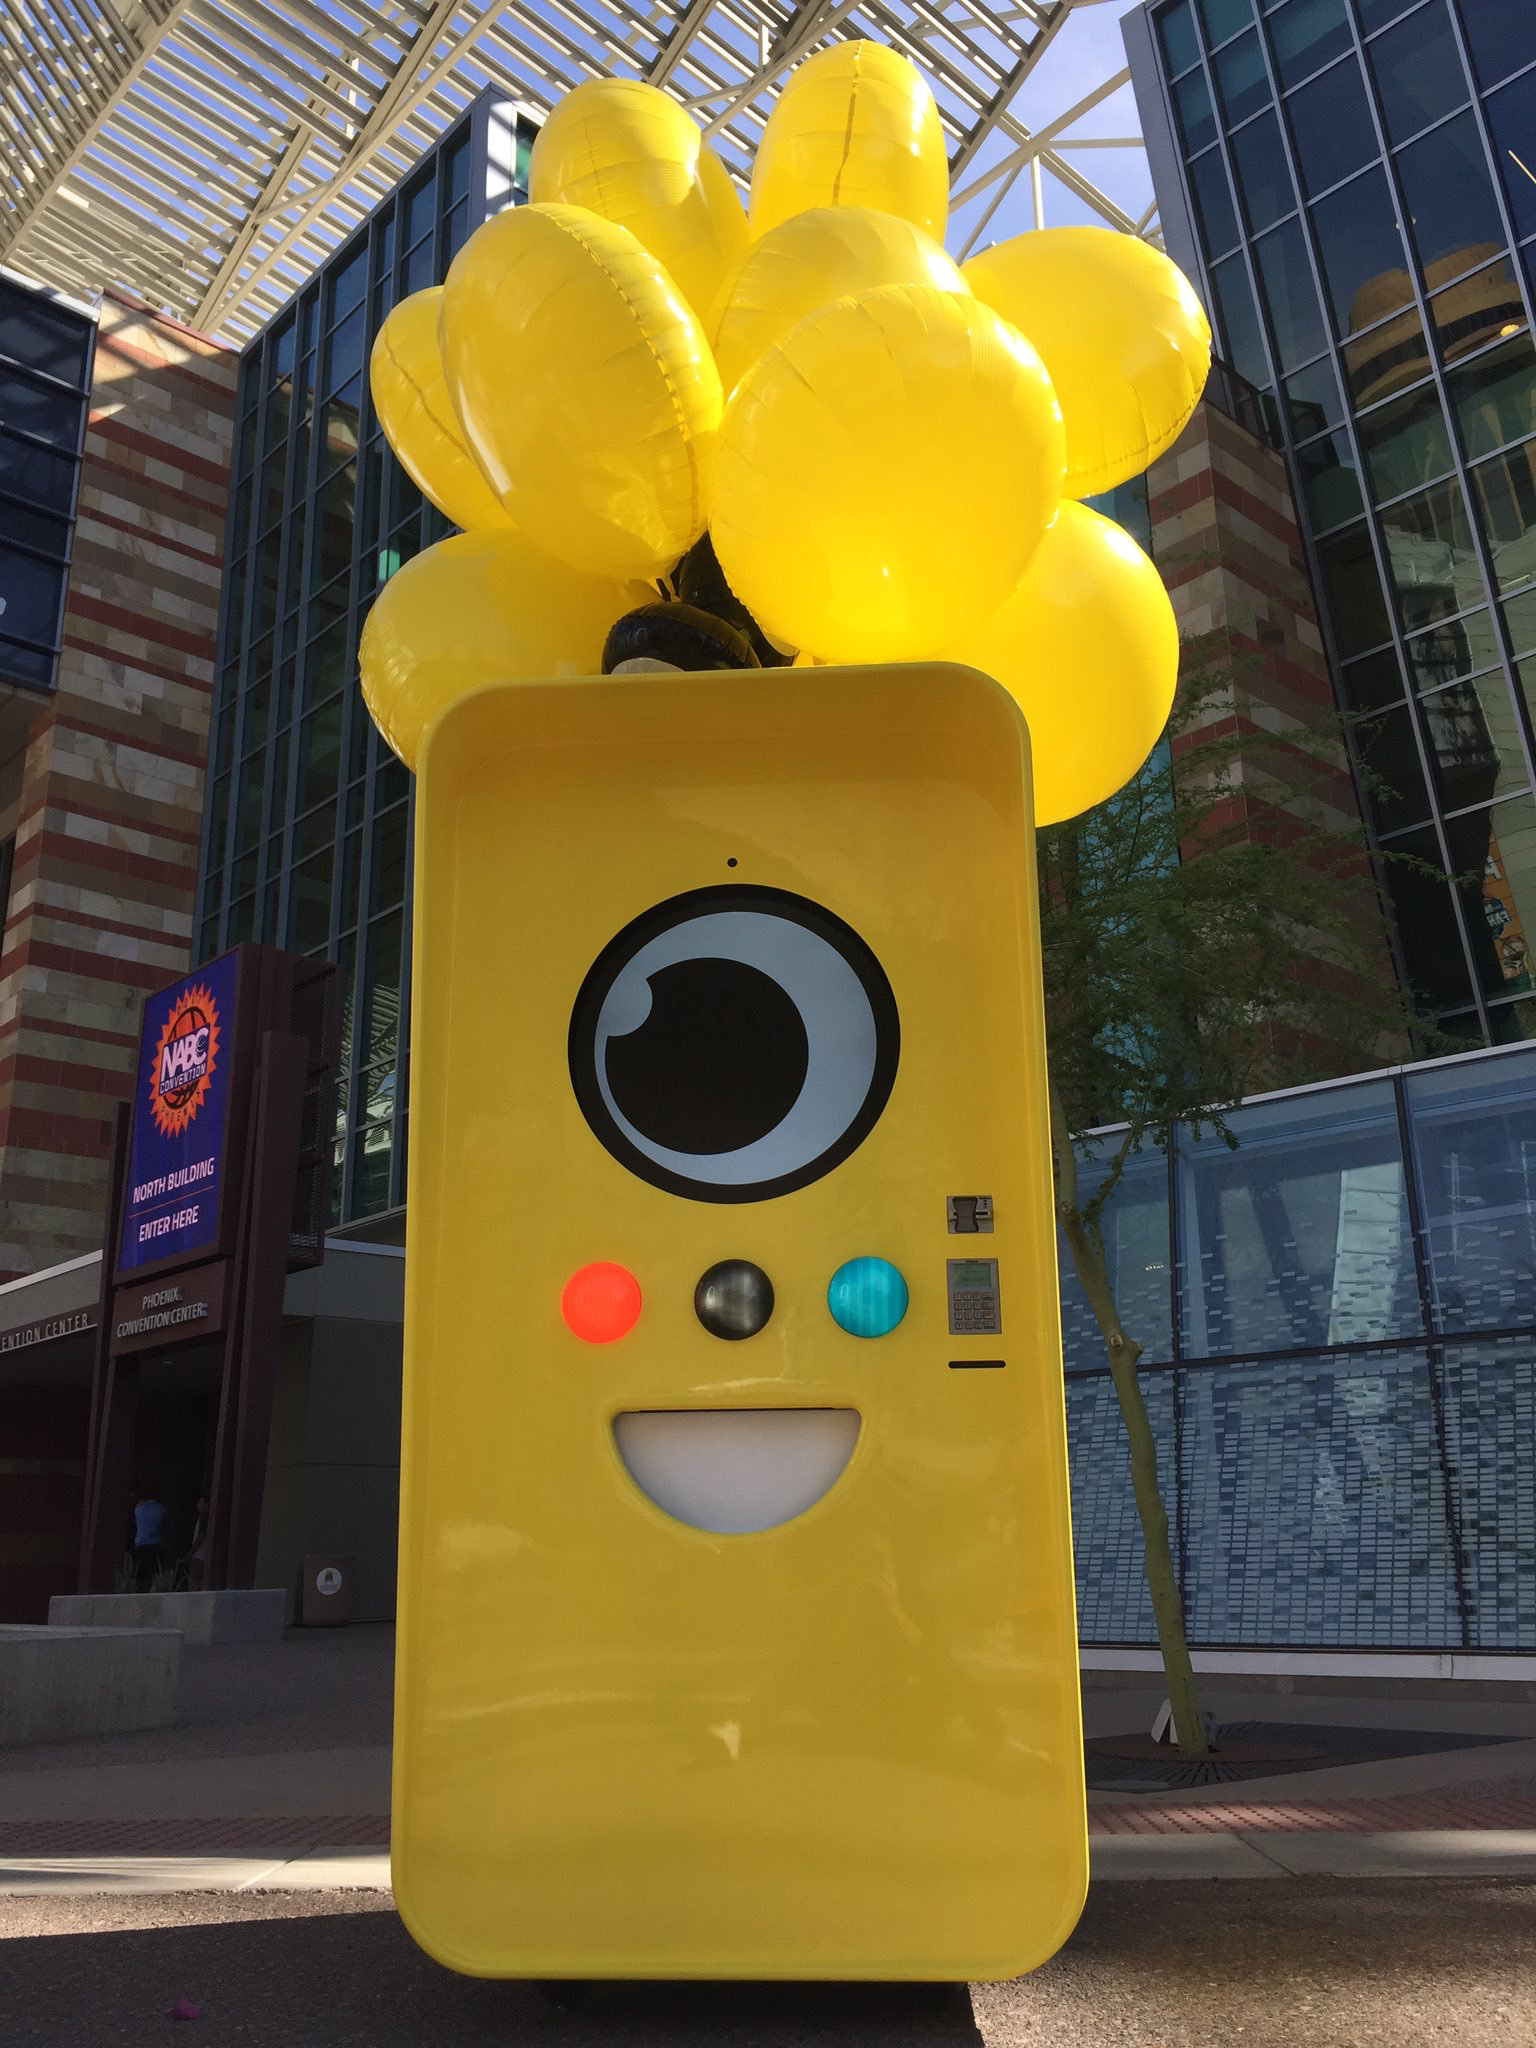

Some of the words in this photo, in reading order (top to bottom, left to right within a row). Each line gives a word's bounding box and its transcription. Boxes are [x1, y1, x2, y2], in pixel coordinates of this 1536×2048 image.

[160, 1026, 210, 1083] NABC
[159, 1062, 207, 1094] CONVENTION
[132, 1176, 167, 1204] NORTH
[167, 1156, 215, 1191] BUILDING
[138, 1215, 171, 1243] ENTER
[171, 1204, 200, 1231] HERE
[141, 1286, 181, 1310] PHOENIX
[45, 1312, 89, 1339] CENTER
[116, 1310, 171, 1338] CONVENTION
[170, 1301, 205, 1324] CENTER
